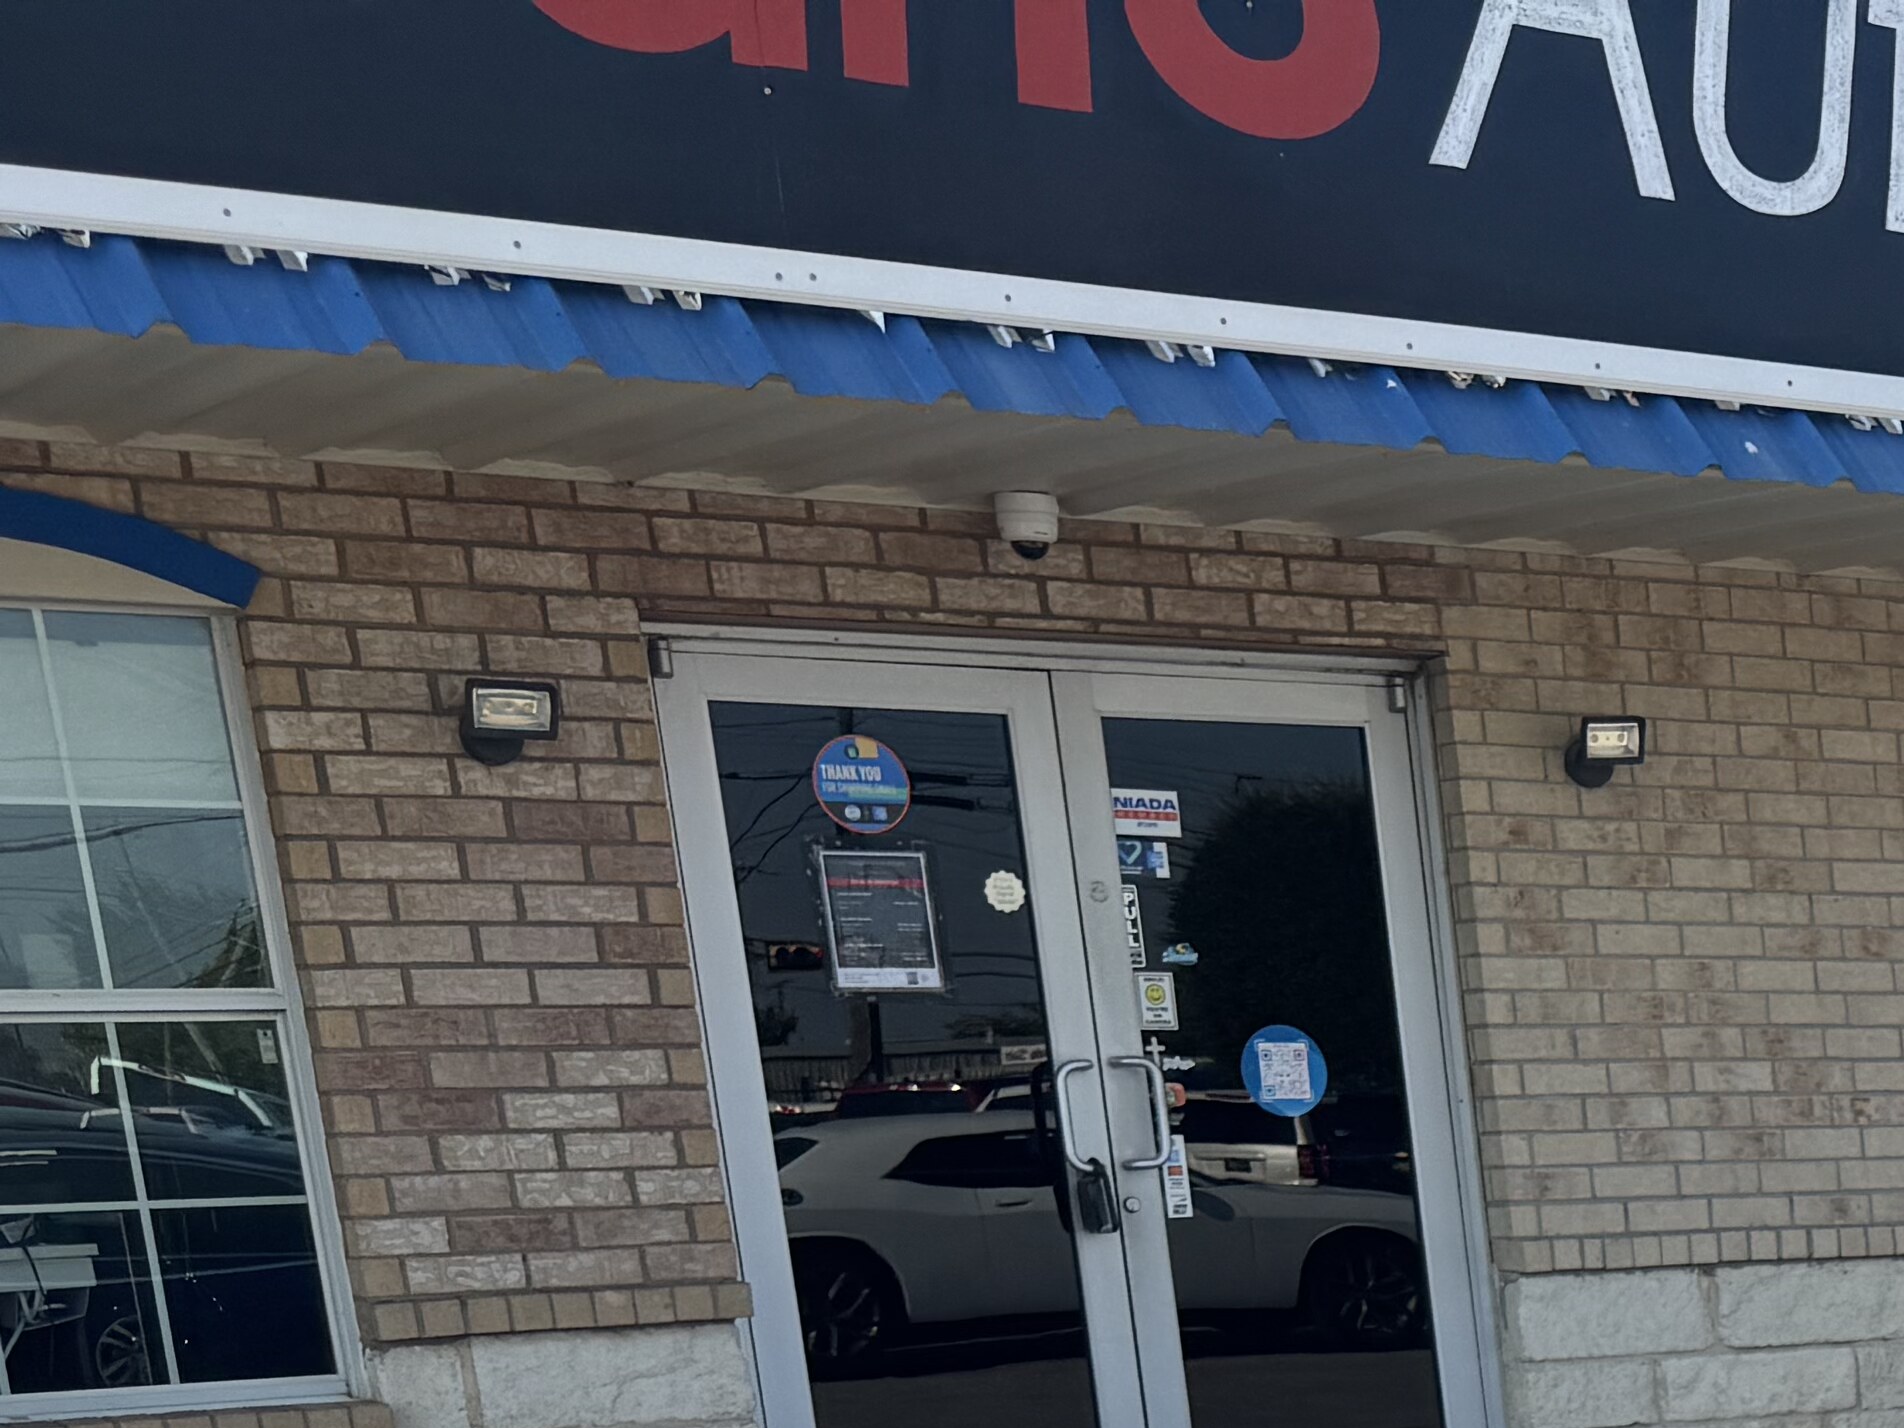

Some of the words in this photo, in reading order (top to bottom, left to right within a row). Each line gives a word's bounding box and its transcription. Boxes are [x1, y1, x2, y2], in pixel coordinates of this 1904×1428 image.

[820, 763, 858, 781] THANK
[858, 765, 882, 782] YOU
[1112, 796, 1177, 811] NIADA
[1123, 892, 1140, 948] PULL
